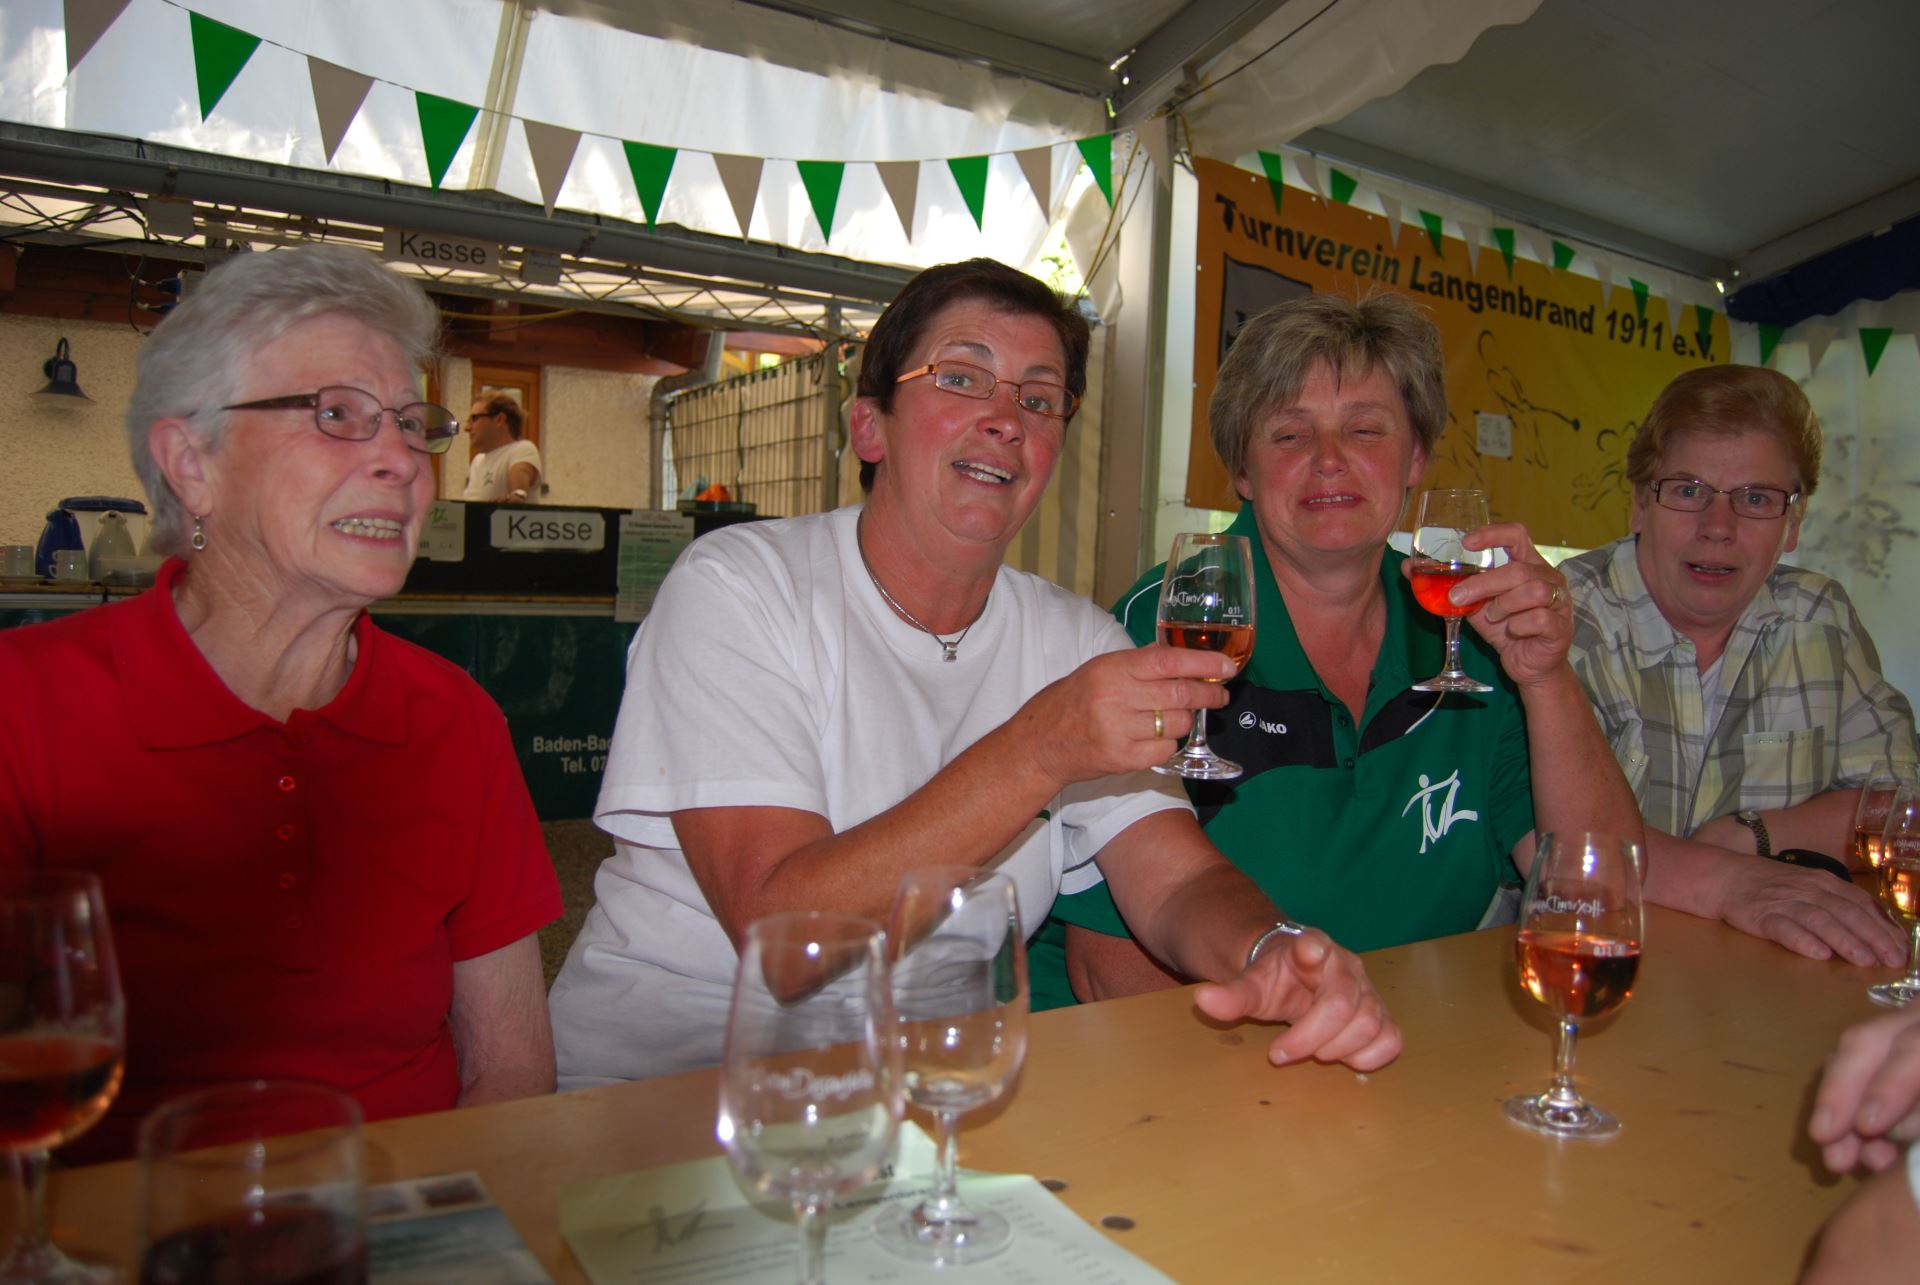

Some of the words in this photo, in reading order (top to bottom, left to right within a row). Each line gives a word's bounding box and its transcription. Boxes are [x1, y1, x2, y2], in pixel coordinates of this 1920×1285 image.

[400, 231, 487, 265] Kasse
[1215, 192, 1400, 285] Turnverein
[1409, 255, 1595, 335] Langenbrand
[1605, 309, 1664, 352] 1911
[1672, 330, 1715, 362] e.V.
[507, 515, 593, 541] Kasse
[560, 755, 588, 773] Tel.
